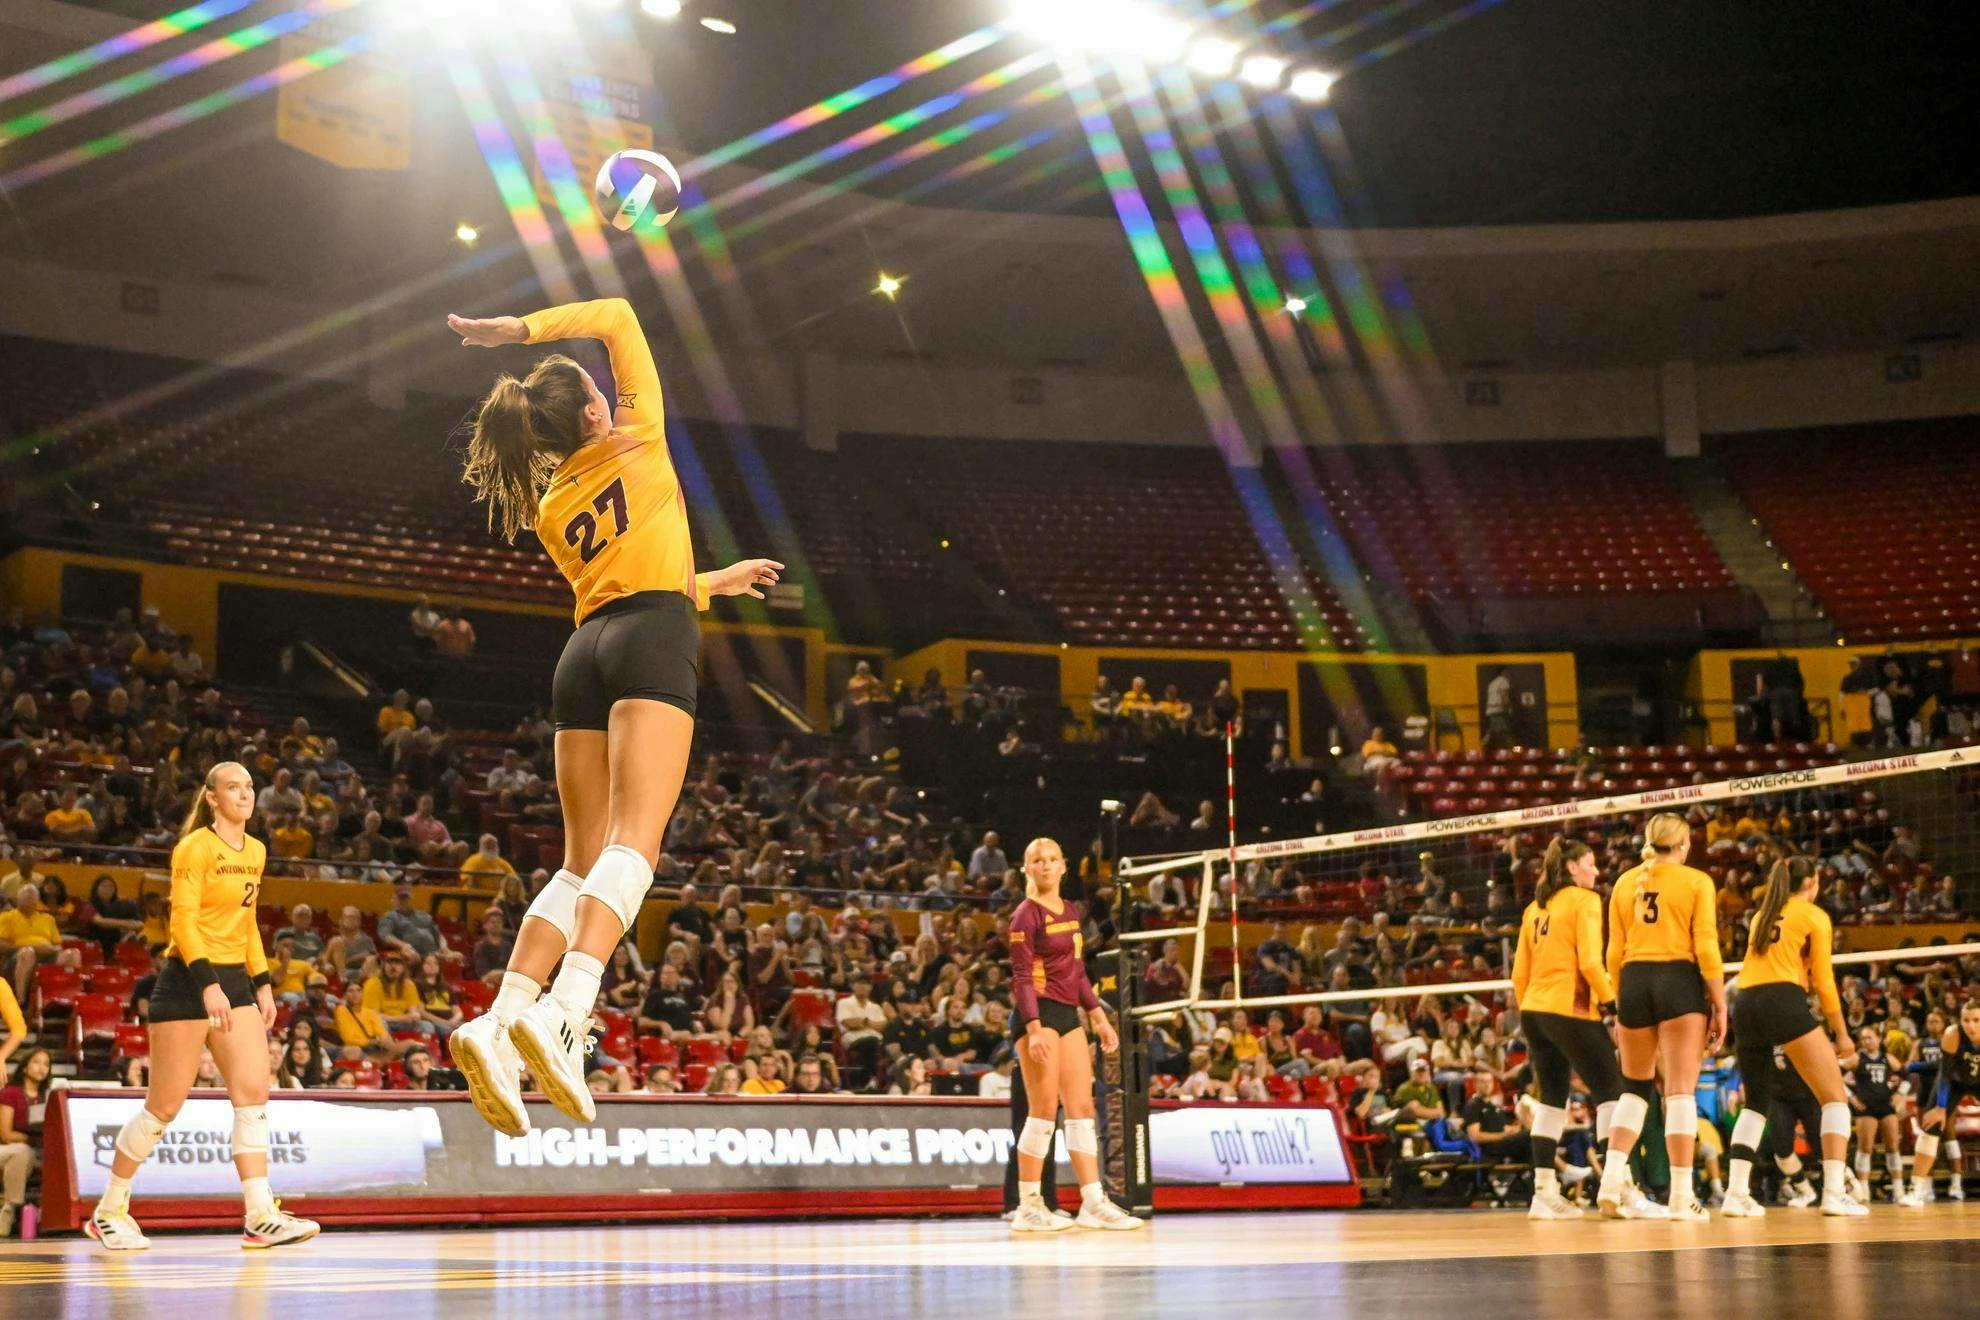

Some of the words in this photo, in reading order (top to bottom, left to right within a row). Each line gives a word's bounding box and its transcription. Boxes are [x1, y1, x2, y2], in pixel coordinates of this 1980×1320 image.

[564, 477, 629, 565] 27
[1729, 770, 1817, 792] POWERADE
[1846, 758, 1887, 776] ARIZONA
[1889, 756, 1919, 771] STATE
[1640, 790, 1676, 804] ARIZONA
[1643, 891, 1659, 924] 3
[494, 1127, 913, 1167] HIGH-PERFORMANCE
[1211, 1120, 1249, 1176] got
[1252, 1117, 1314, 1165] milk?
